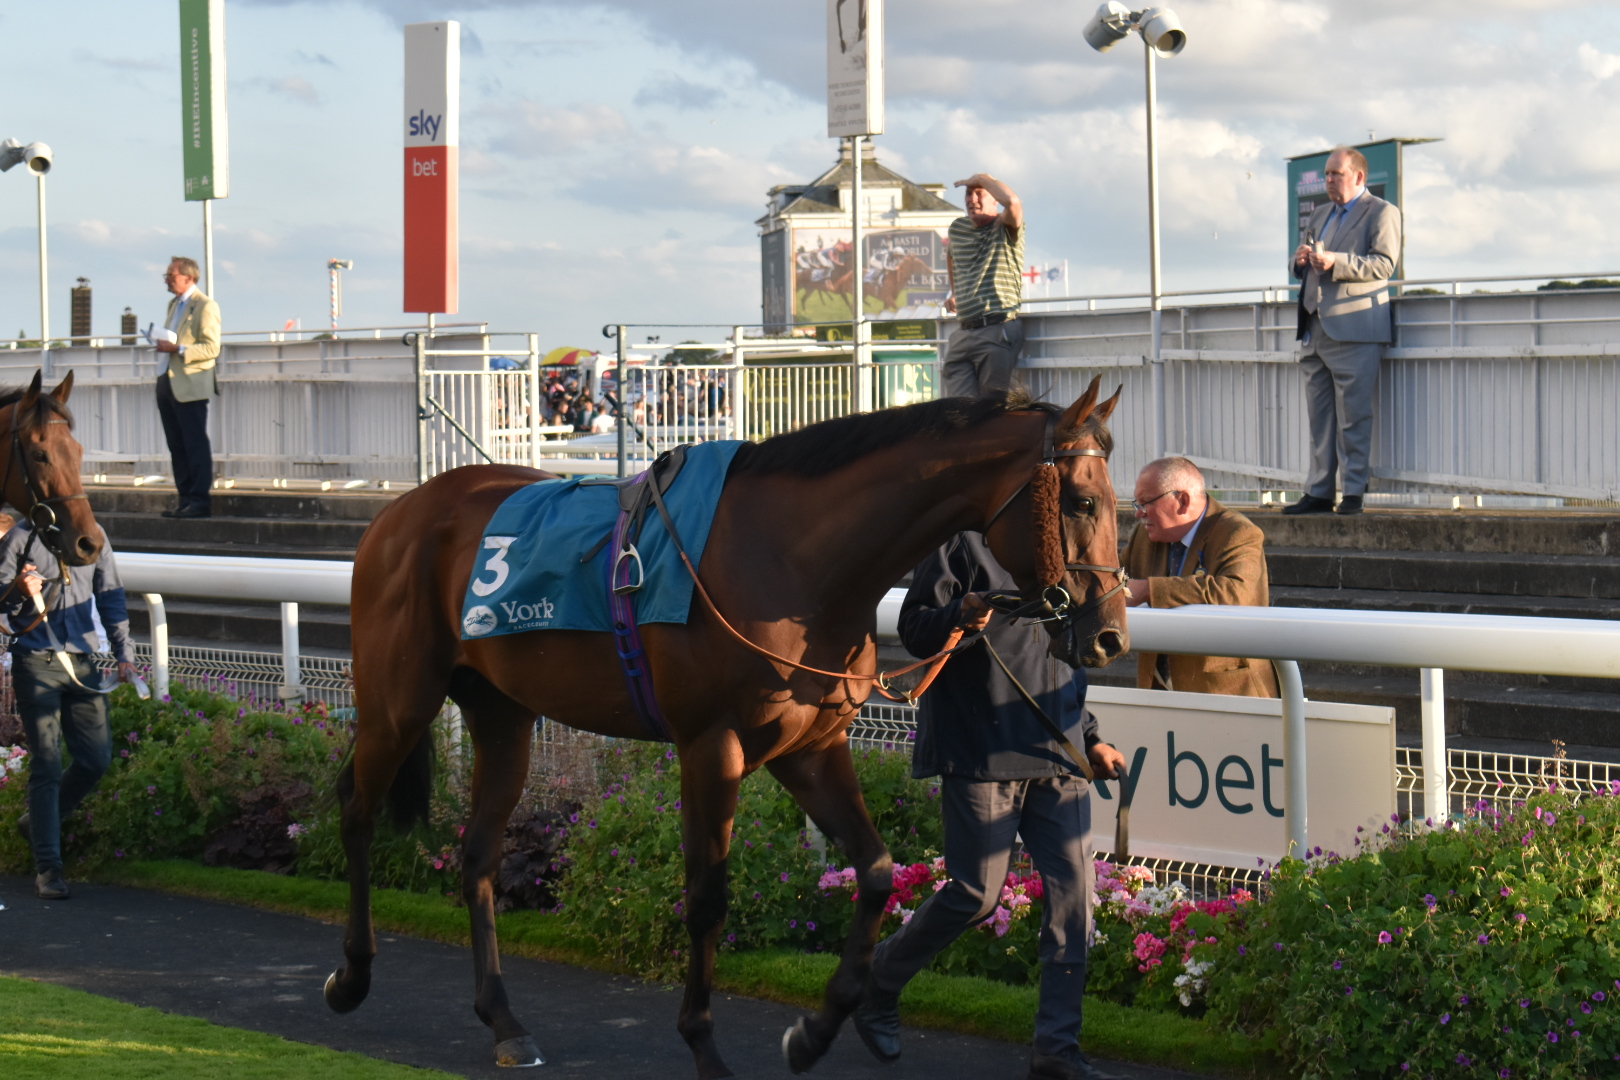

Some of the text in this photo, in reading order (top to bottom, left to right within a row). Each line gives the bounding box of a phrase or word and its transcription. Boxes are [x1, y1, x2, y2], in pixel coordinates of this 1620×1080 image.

[191, 27, 201, 149] #IREIncentive
[409, 109, 442, 141] sky
[413, 158, 438, 176] bet
[894, 236, 920, 246] BASTI
[921, 273, 949, 285] BAST
[472, 536, 518, 597] 3
[500, 597, 555, 623] York
[1167, 730, 1284, 818] bet
